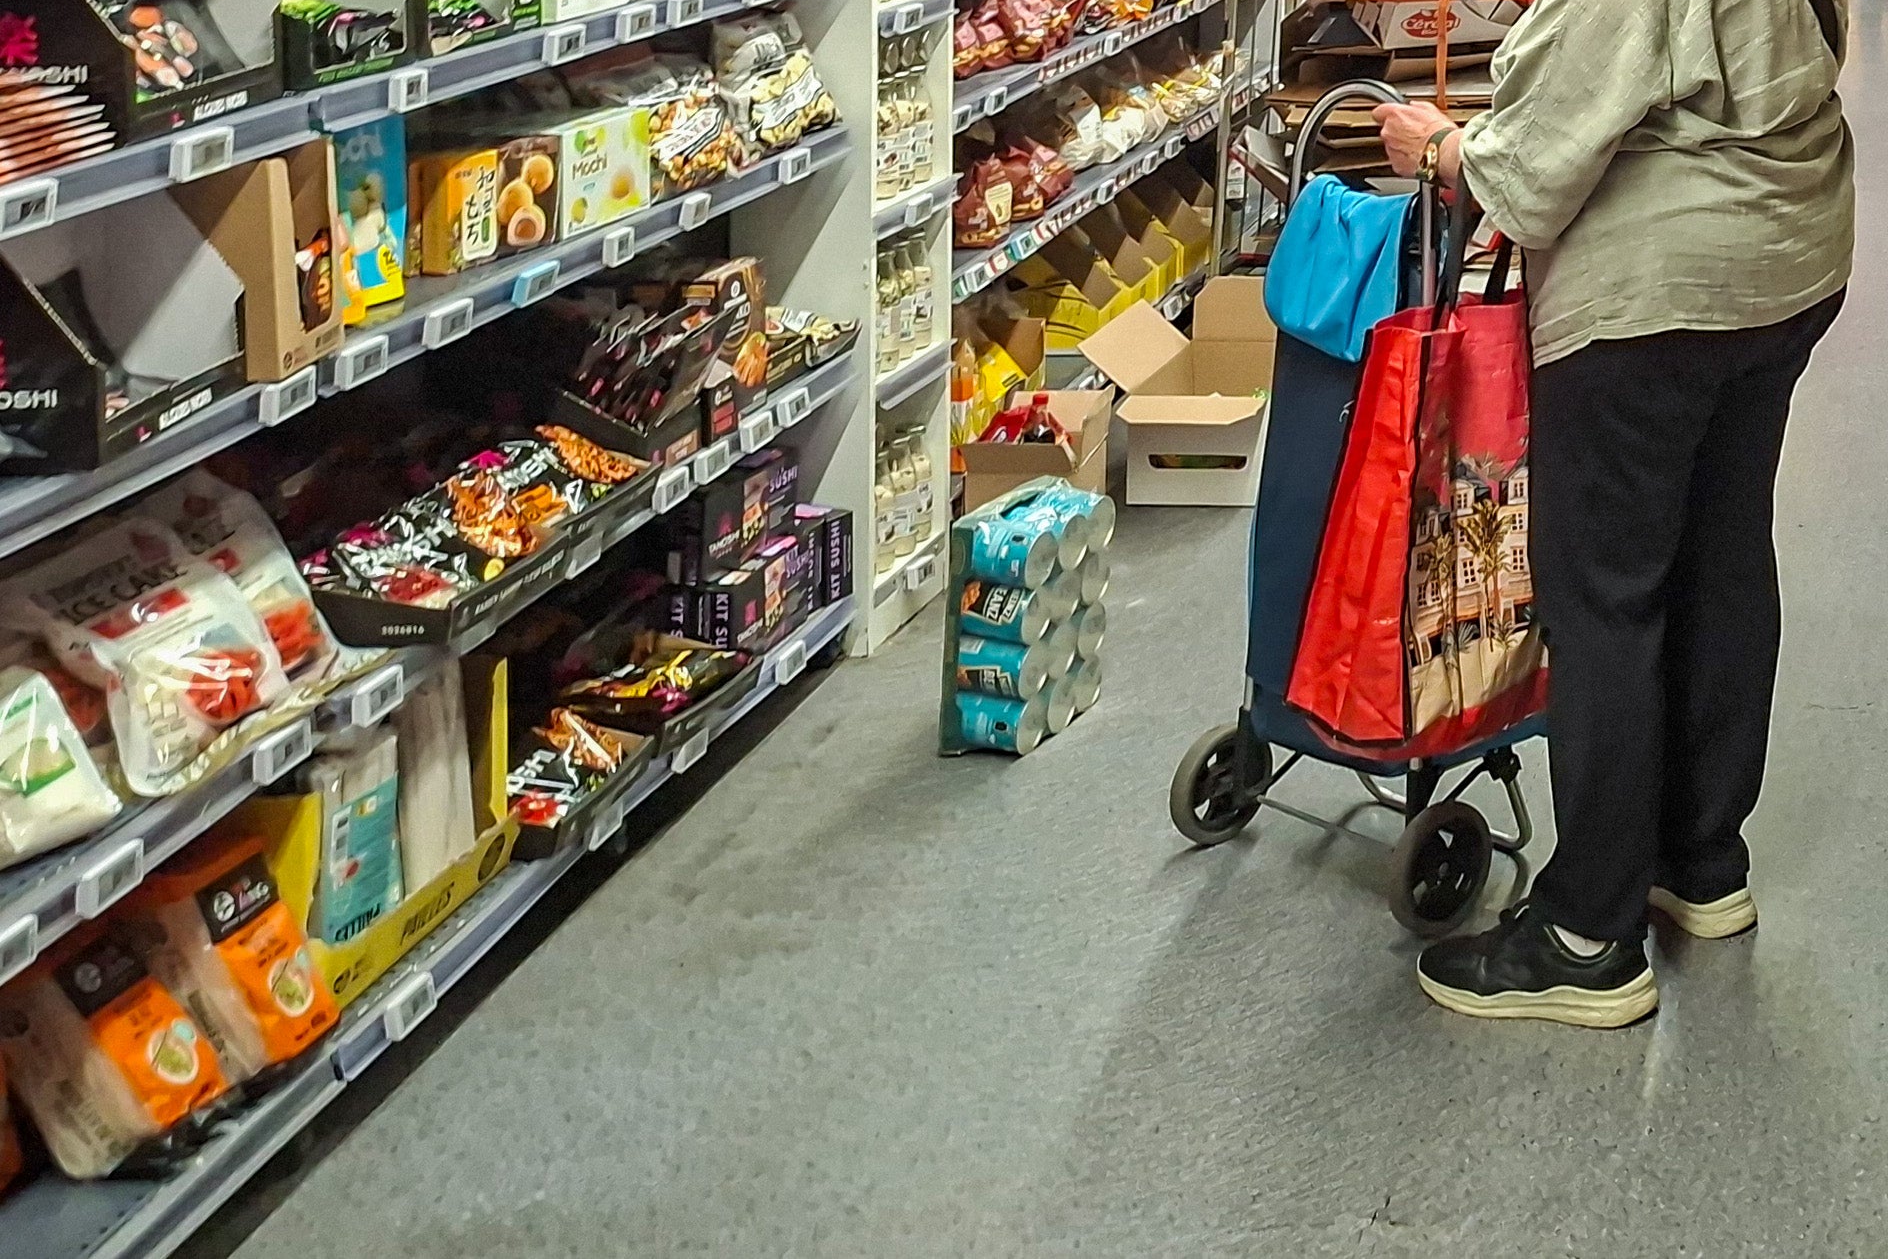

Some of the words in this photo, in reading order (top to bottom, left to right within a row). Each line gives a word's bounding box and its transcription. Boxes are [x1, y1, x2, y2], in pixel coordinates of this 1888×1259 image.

[572, 158, 608, 181] Mochi
[769, 464, 799, 493] SUSHI
[830, 520, 841, 569] SUSHI
[831, 573, 841, 599] KIT
[715, 592, 729, 622] KIT
